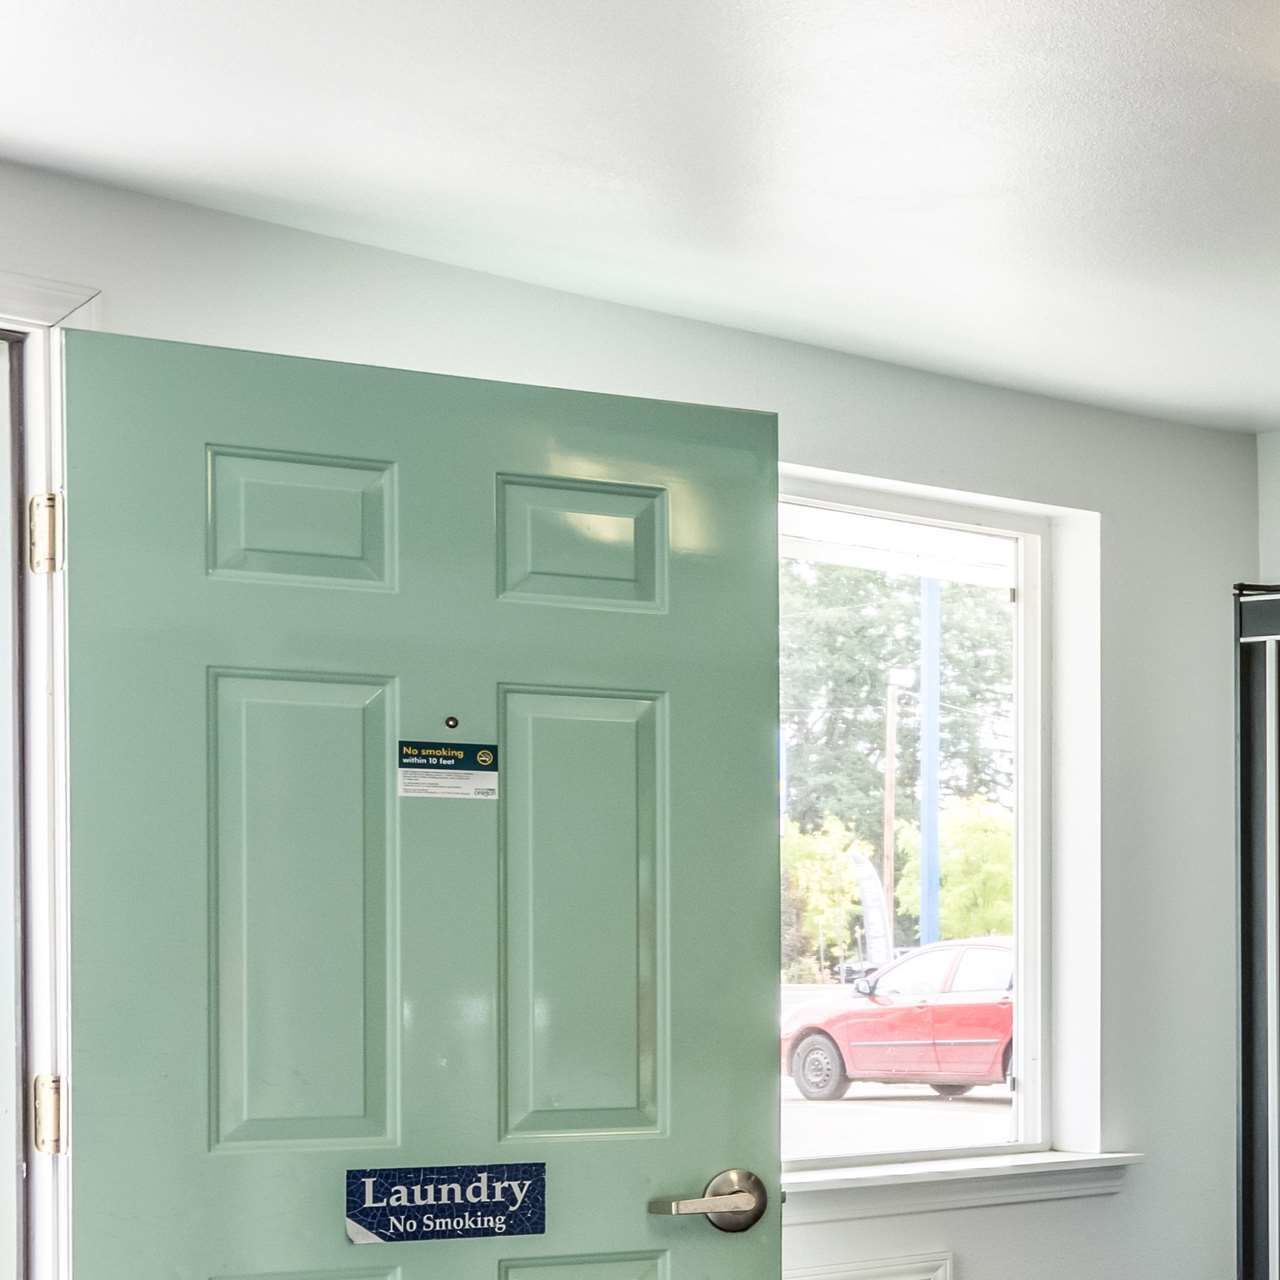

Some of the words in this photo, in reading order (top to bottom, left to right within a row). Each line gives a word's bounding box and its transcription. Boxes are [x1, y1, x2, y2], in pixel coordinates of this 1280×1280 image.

[402, 746, 419, 756] No
[421, 748, 464, 759] smoking
[402, 757, 427, 765] within
[429, 757, 438, 765] 10
[439, 758, 455, 766] feet
[361, 1172, 532, 1211] Laundry
[388, 1216, 417, 1233] No
[423, 1212, 506, 1232] Smoking
